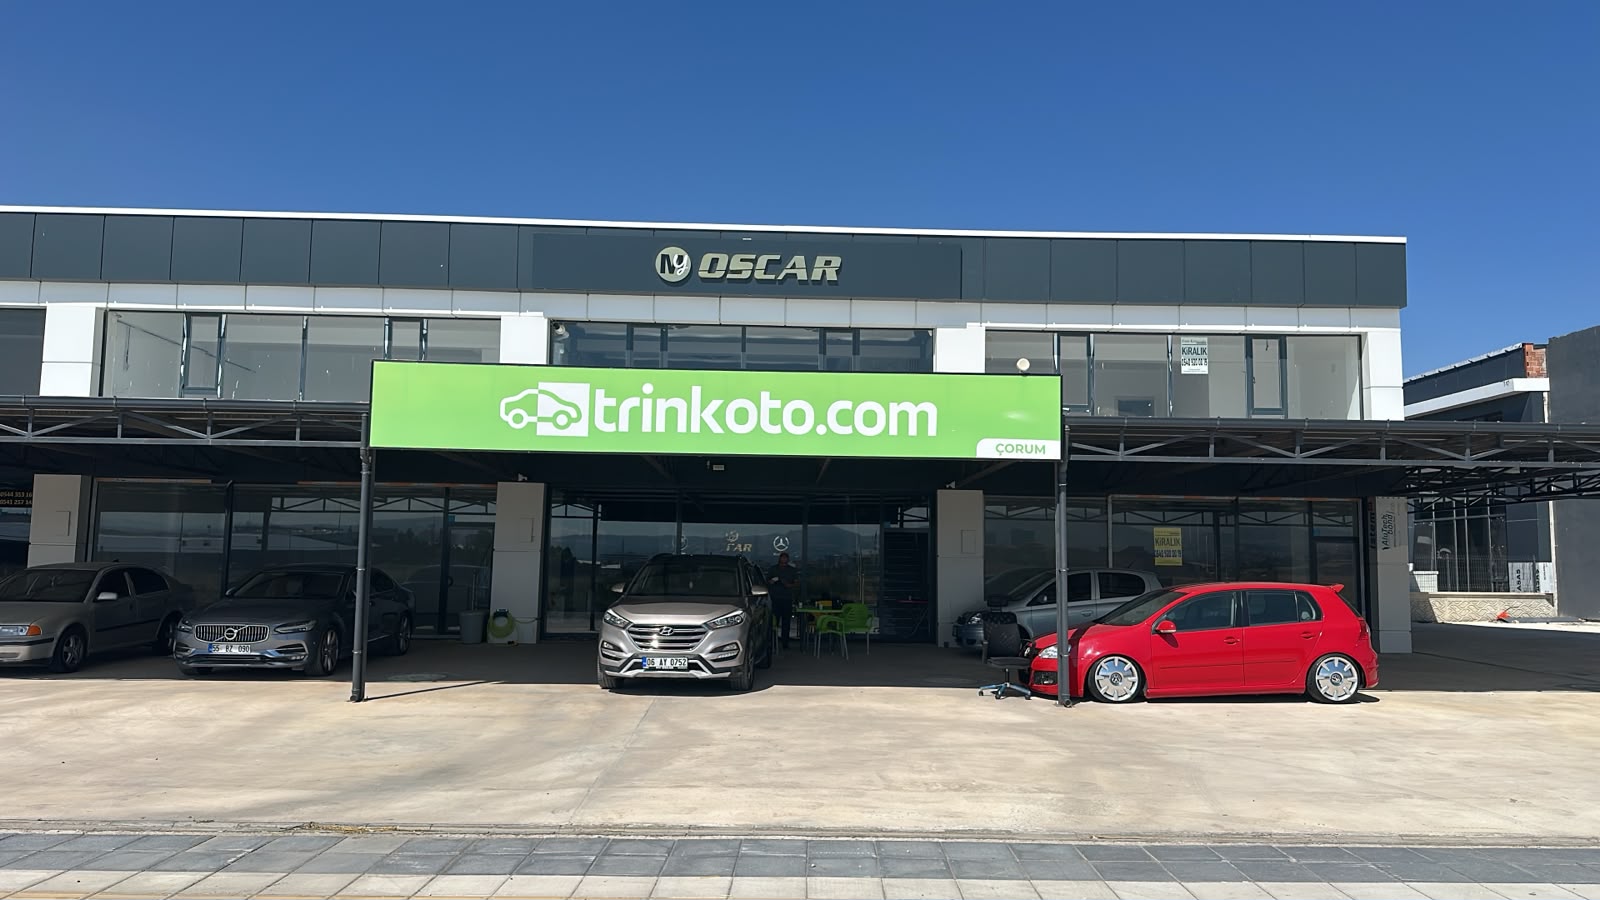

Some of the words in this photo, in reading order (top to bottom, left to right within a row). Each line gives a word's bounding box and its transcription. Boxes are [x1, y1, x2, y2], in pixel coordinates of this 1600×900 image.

[698, 253, 841, 281] OSCAR
[594, 383, 938, 437] trinkoto.com
[995, 443, 1046, 456] ÇORUM
[647, 658, 656, 666] 06
[660, 658, 667, 666] AY
[671, 658, 687, 666] 0752
